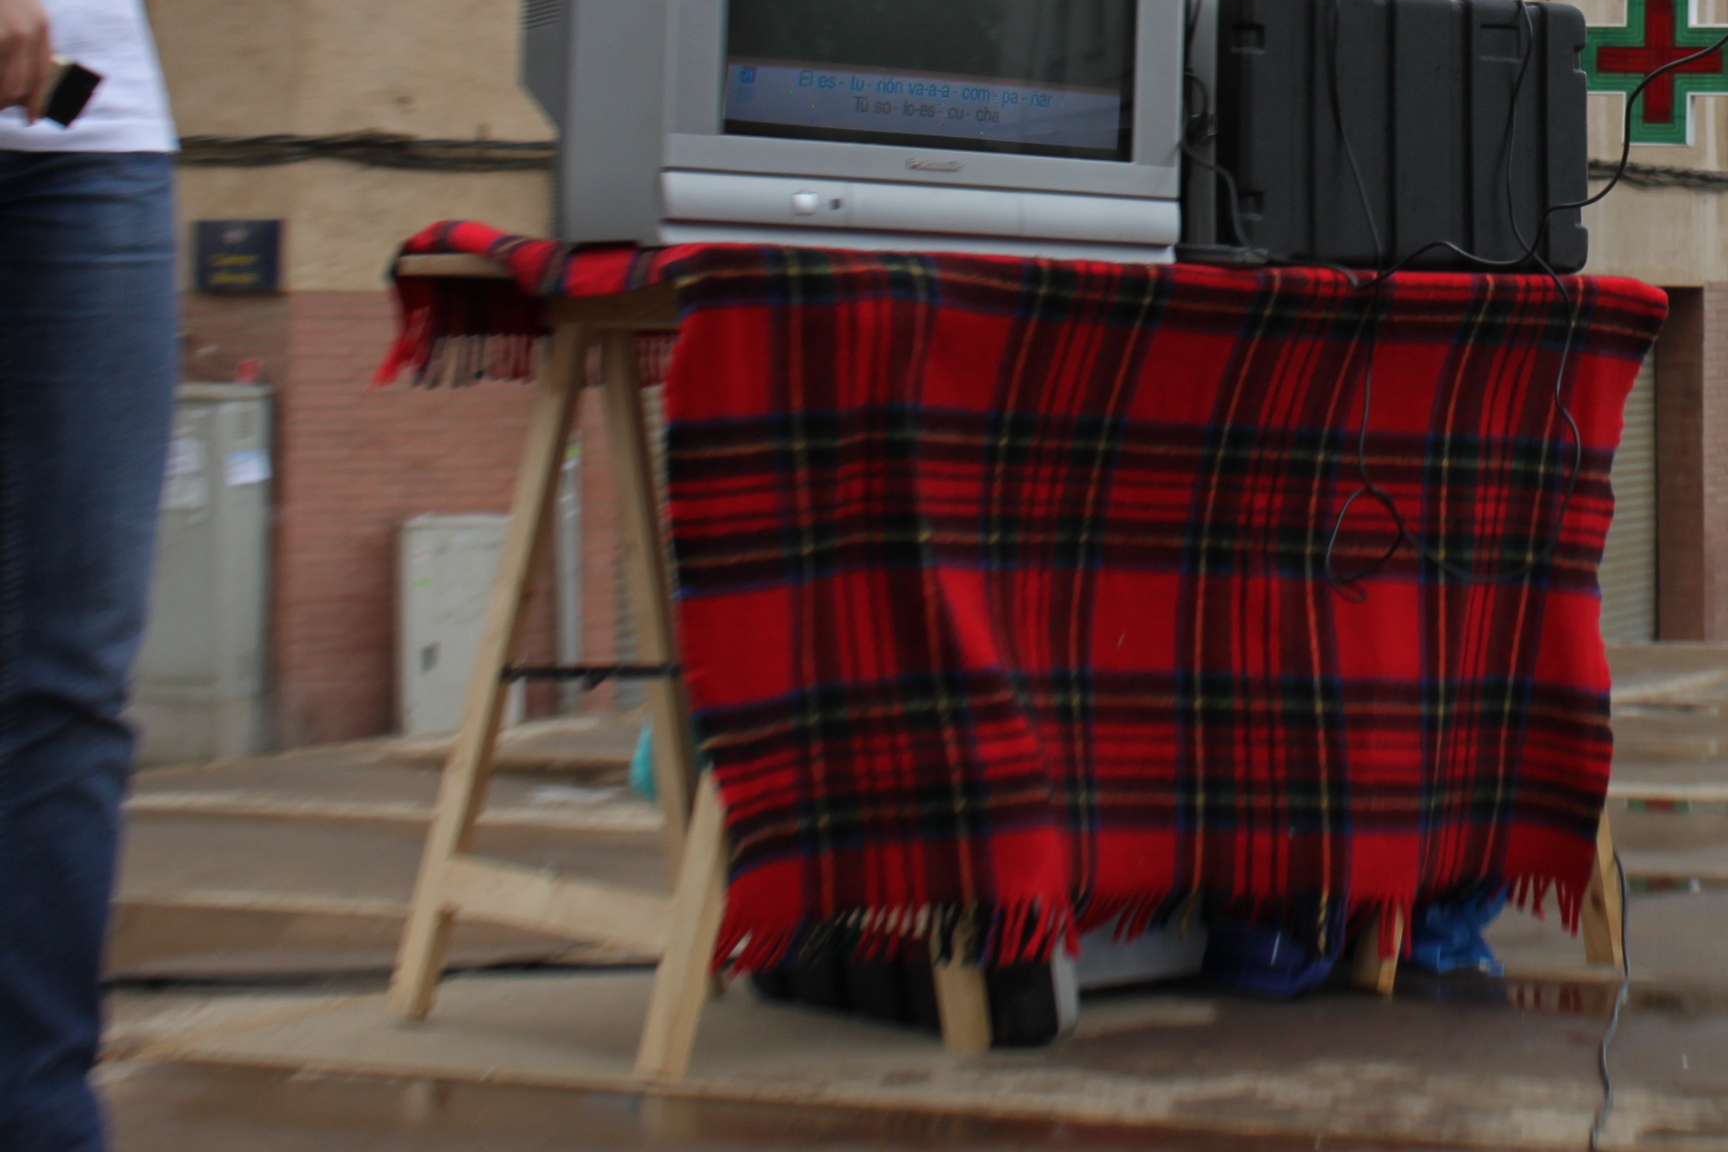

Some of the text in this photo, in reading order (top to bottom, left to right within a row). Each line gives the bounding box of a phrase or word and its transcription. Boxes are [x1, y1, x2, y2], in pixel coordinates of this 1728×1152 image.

[799, 70, 814, 87] El
[876, 76, 903, 94] rión
[975, 106, 1000, 123] cha
